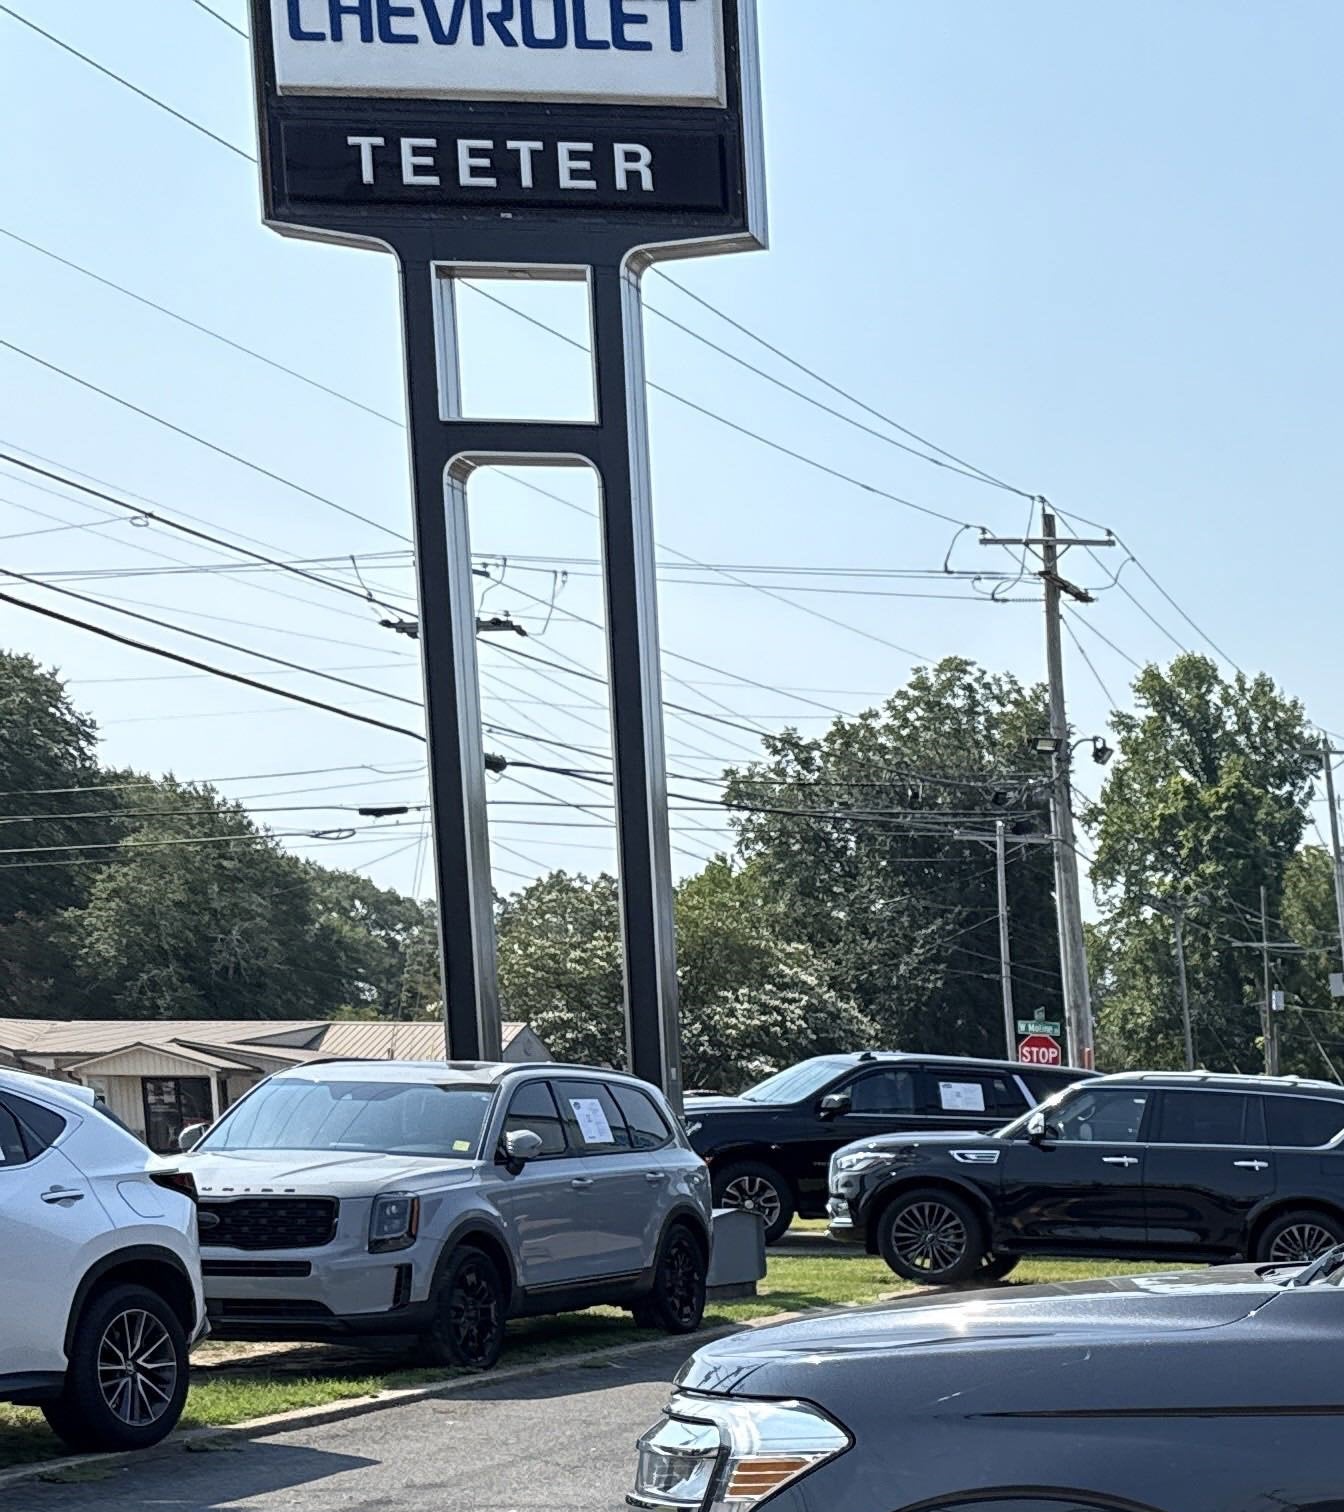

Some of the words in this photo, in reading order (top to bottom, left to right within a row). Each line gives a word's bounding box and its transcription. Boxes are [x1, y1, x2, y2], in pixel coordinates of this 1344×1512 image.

[287, 0, 695, 52] CHEVROLET
[347, 136, 655, 192] TEETER
[1022, 1047, 1058, 1063] STOP
